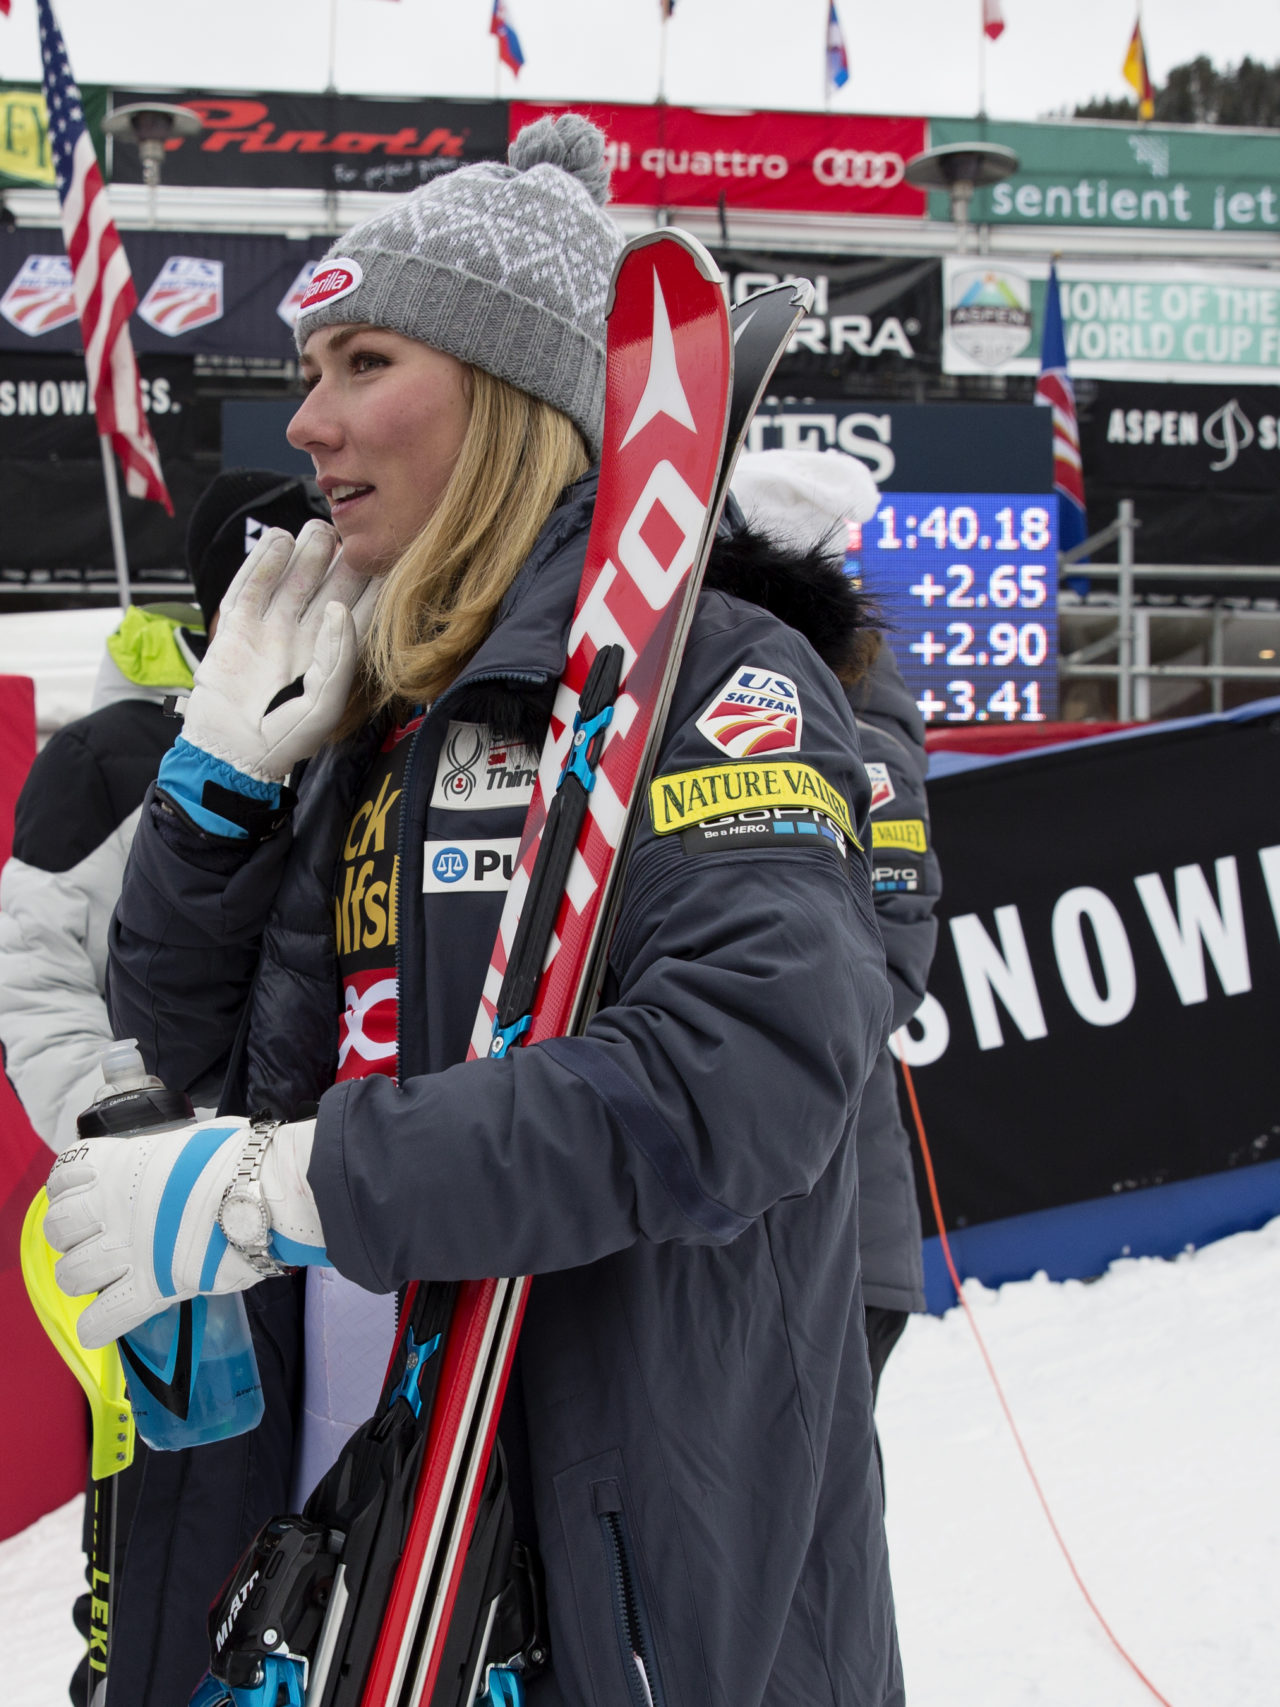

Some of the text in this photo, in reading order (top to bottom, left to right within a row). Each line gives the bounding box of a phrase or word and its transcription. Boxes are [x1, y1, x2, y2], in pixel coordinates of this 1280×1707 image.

[641, 148, 788, 180] quattro
[992, 179, 1279, 231] sentient jet
[1161, 285, 1209, 322] OF
[1213, 287, 1279, 325] THE
[1183, 323, 1254, 363] CUP
[1106, 408, 1199, 446] ASPEN
[877, 506, 1051, 551] 1:40.18
[909, 564, 1048, 609] +2.65
[909, 622, 1048, 667] +2.90
[724, 692, 798, 716] SKI TEAM
[737, 672, 796, 699] US
[916, 680, 1047, 722] +3.41
[661, 769, 781, 825] NATURE
[704, 824, 770, 839] Be a HERO.
[877, 822, 922, 849] VALLEY
[89, 1567, 111, 1673] LEKI
